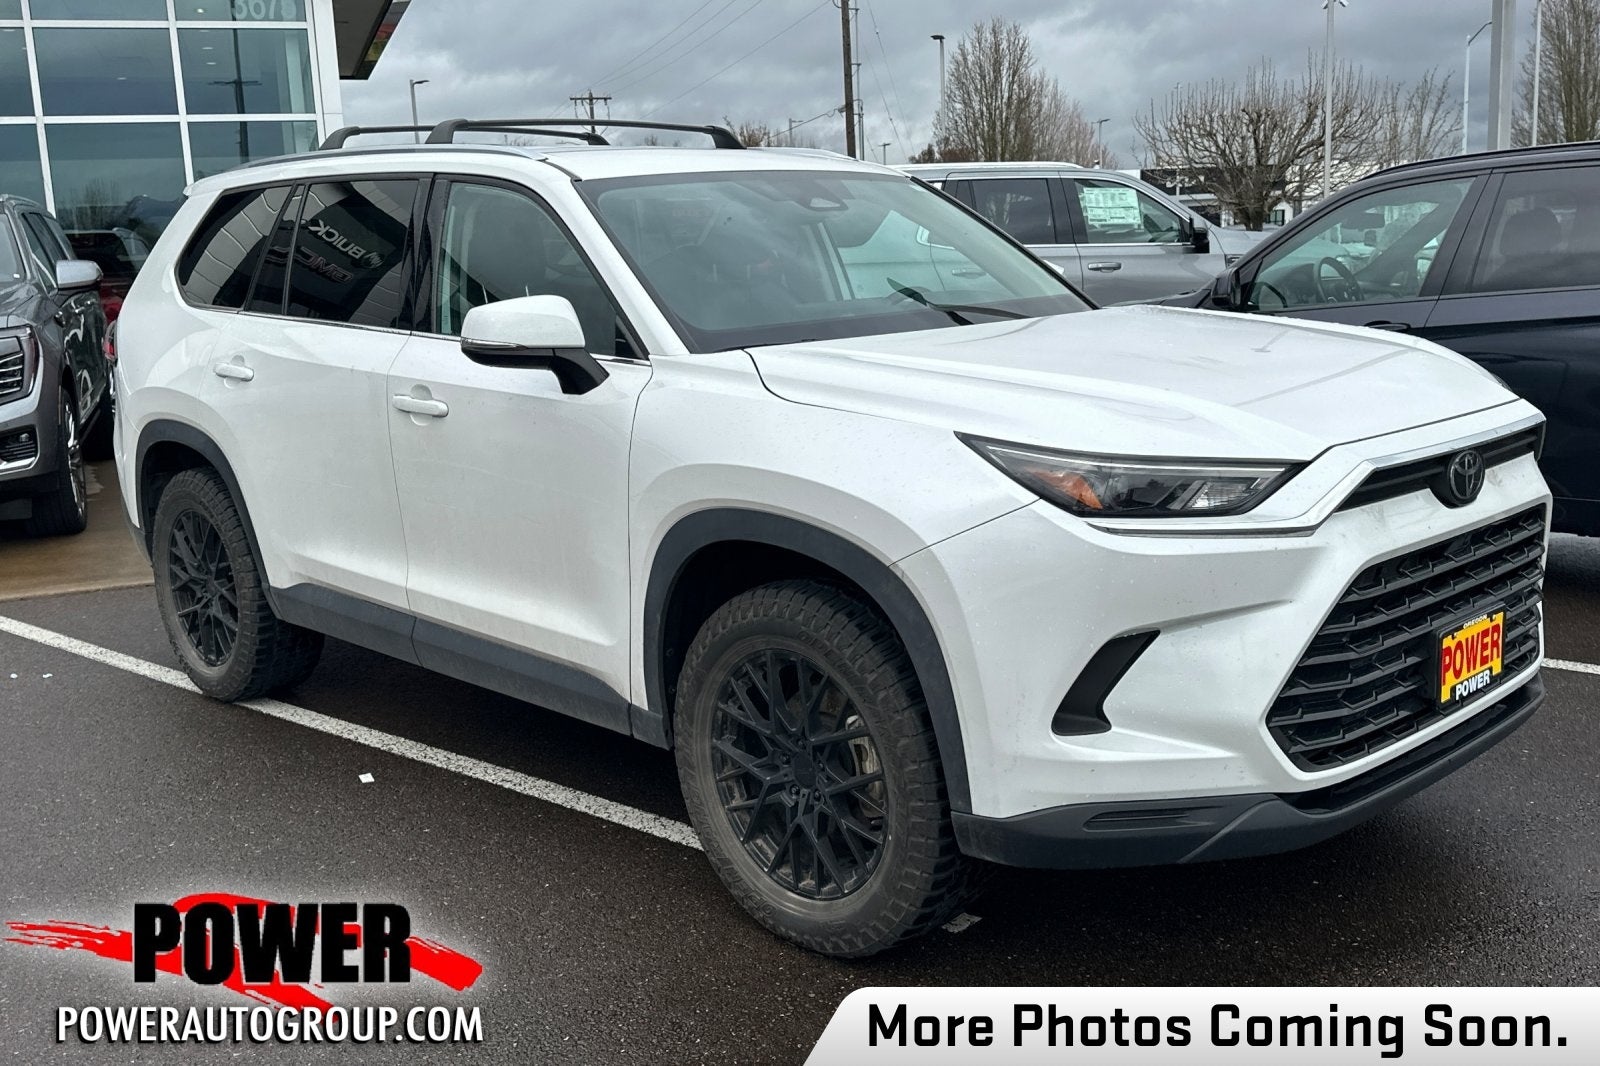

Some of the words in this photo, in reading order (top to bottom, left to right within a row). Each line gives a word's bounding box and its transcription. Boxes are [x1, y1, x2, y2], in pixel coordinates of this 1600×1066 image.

[1463, 614, 1488, 630] OREGON
[1442, 623, 1501, 686] POWER
[1455, 669, 1490, 701] POWER
